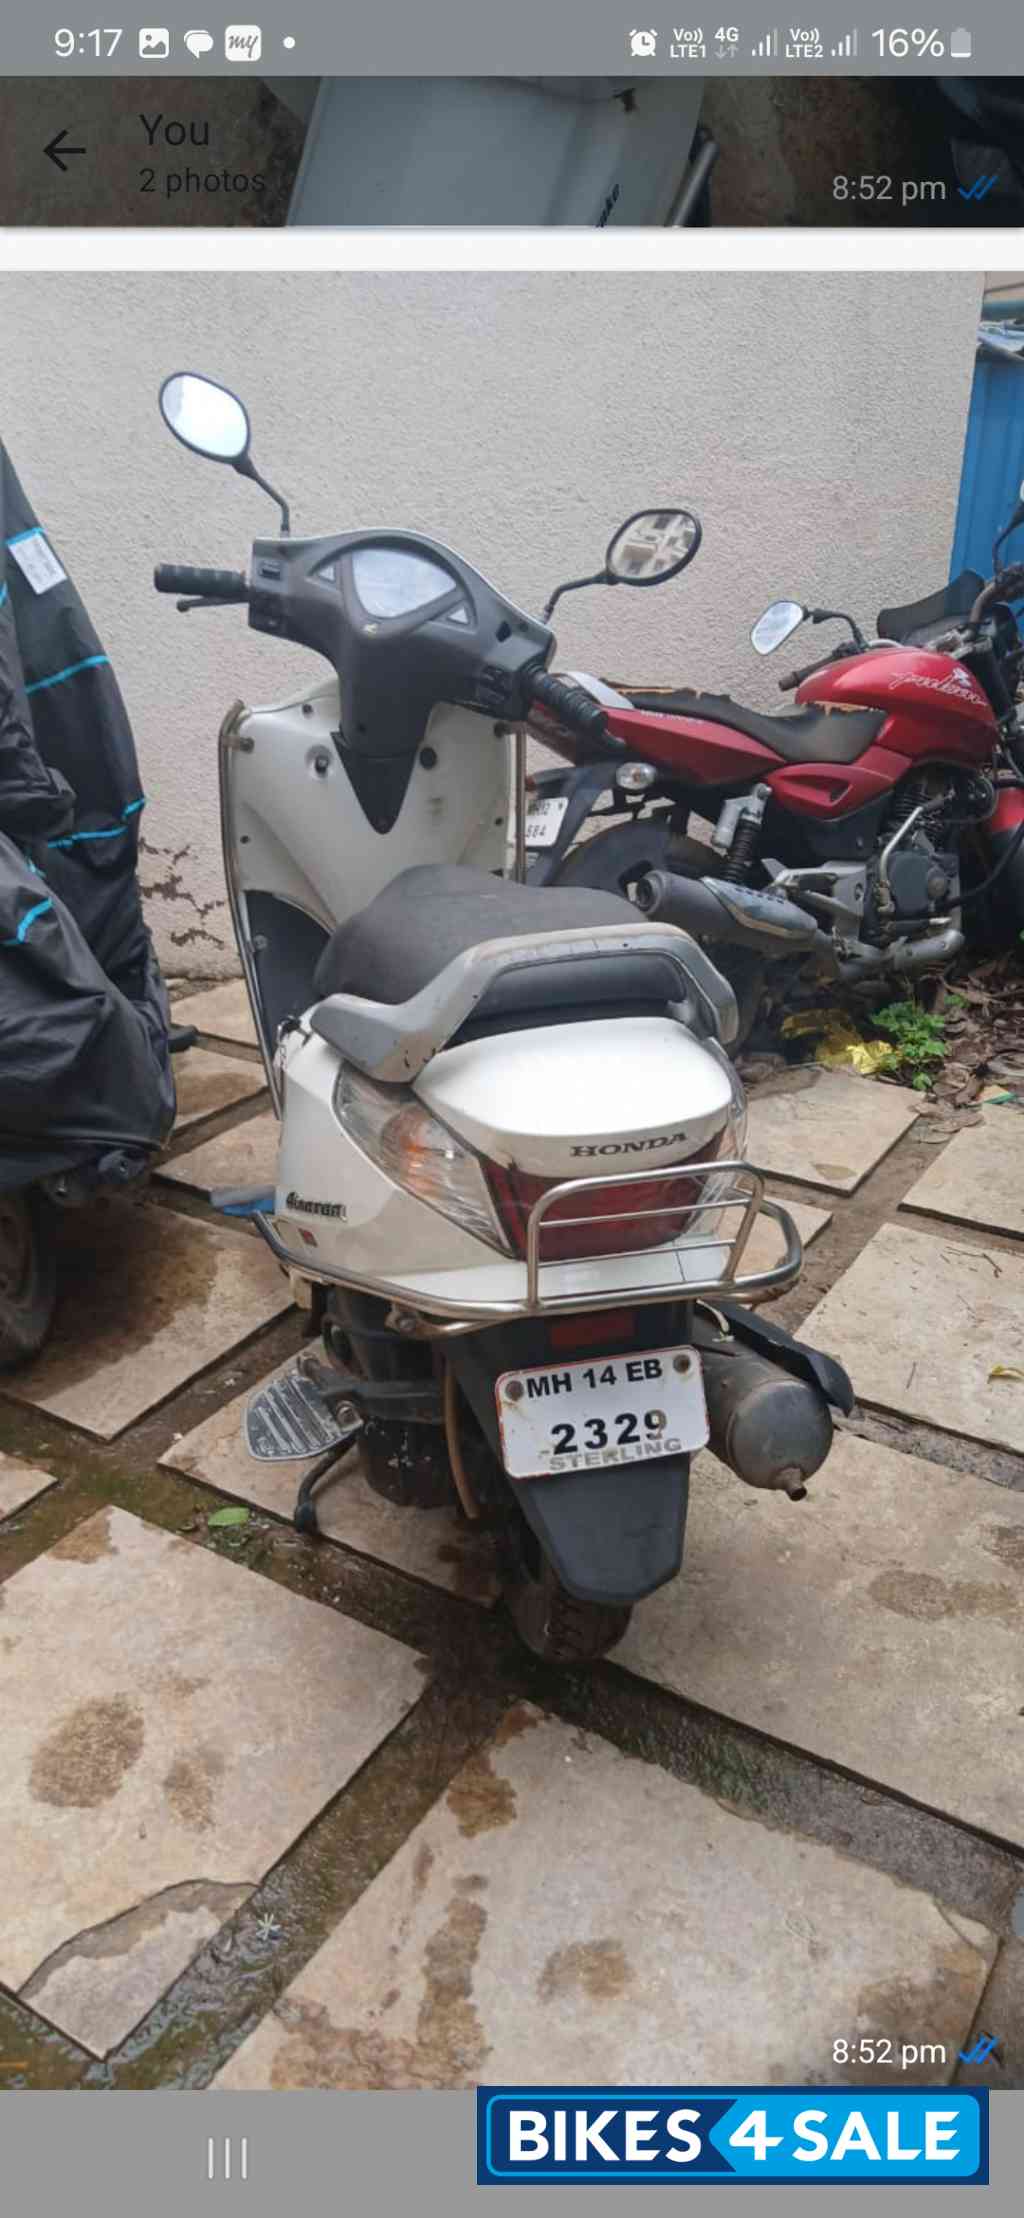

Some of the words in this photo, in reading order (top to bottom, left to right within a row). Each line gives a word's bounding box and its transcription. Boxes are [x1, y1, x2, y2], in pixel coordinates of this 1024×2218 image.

[570, 1132, 687, 1157] HONDA
[526, 1373, 572, 1398] MH
[583, 1365, 617, 1389] 14
[625, 1358, 663, 1383] EB
[551, 1408, 667, 1455] 2329
[549, 1437, 682, 1471] STERLING
